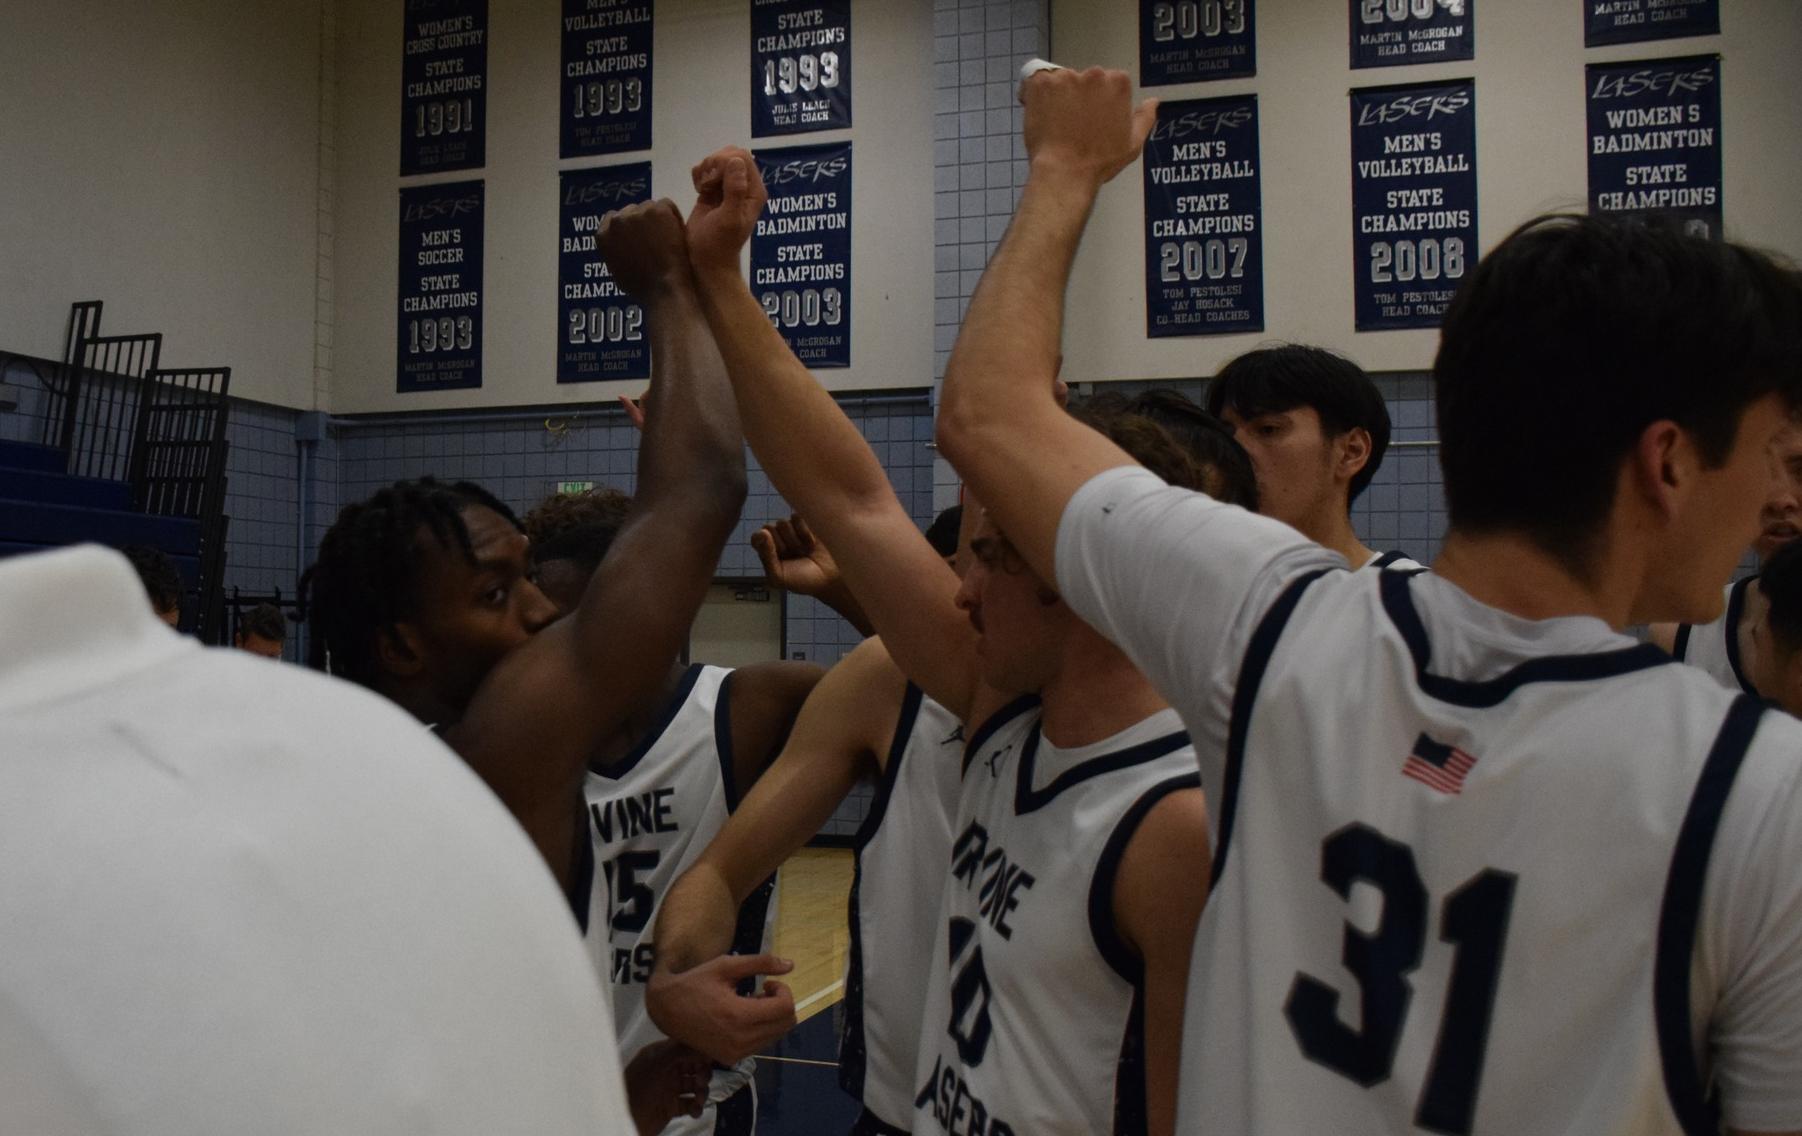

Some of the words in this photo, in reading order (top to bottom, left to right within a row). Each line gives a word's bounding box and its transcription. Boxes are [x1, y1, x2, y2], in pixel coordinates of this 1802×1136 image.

[1595, 0, 1639, 15] MARTIN
[1614, 12, 1645, 26] HEAD
[1651, 8, 1688, 22] COACH
[564, 7, 650, 32] VOLLEYBALL
[778, 9, 823, 30] STATE
[1153, 0, 1245, 42] 2003
[438, 29, 483, 50] COUNTRY
[586, 36, 628, 55] STATE
[757, 27, 845, 53] CHAMPIONS
[1360, 32, 1402, 45] MARTIN
[1378, 43, 1406, 56] HEAD
[1412, 40, 1446, 53] COACH
[425, 58, 464, 77] STATE
[567, 53, 647, 77] CHAMPIONS
[764, 50, 839, 96] 1993
[408, 75, 482, 98] CHAMPIONS
[574, 77, 642, 118] 1993
[416, 97, 473, 138] 1991
[801, 111, 829, 123] COACH
[1172, 140, 1227, 162] MEN'S
[1383, 132, 1442, 154] MEN'S
[1593, 128, 1714, 154] BADMINTON
[1150, 159, 1254, 185] VOLLEYBALL
[1358, 154, 1469, 179] VOLLEYBALL
[1625, 164, 1687, 186] STATE
[767, 192, 837, 215] WOMEN'S
[1176, 193, 1230, 213] STATE
[1387, 188, 1443, 209] STATE
[1598, 186, 1716, 211] CHAMPIONS
[757, 212, 847, 237] BADMINTON
[1153, 214, 1255, 238] CHAMPIONS
[1361, 211, 1470, 233] CHAMPIONS
[421, 228, 462, 246] MEN'S
[418, 248, 464, 266] SOCCER
[777, 243, 823, 263] STATE
[1160, 236, 1248, 283] 2007
[1370, 236, 1464, 283] 2008
[420, 274, 460, 291] STATE
[757, 263, 845, 286] CHAMPIONS
[404, 292, 478, 312] CHAMPIONS
[1162, 288, 1184, 299] TOM
[1373, 293, 1397, 304] TOM
[761, 287, 843, 329] 2003
[1171, 300, 1190, 311] JAY
[1206, 310, 1250, 322] COACHES
[1382, 305, 1410, 317] HEAD
[409, 315, 473, 354] 1993
[569, 304, 642, 344] 2002
[799, 348, 827, 359] COACH
[1283, 820, 1520, 1136] 31
